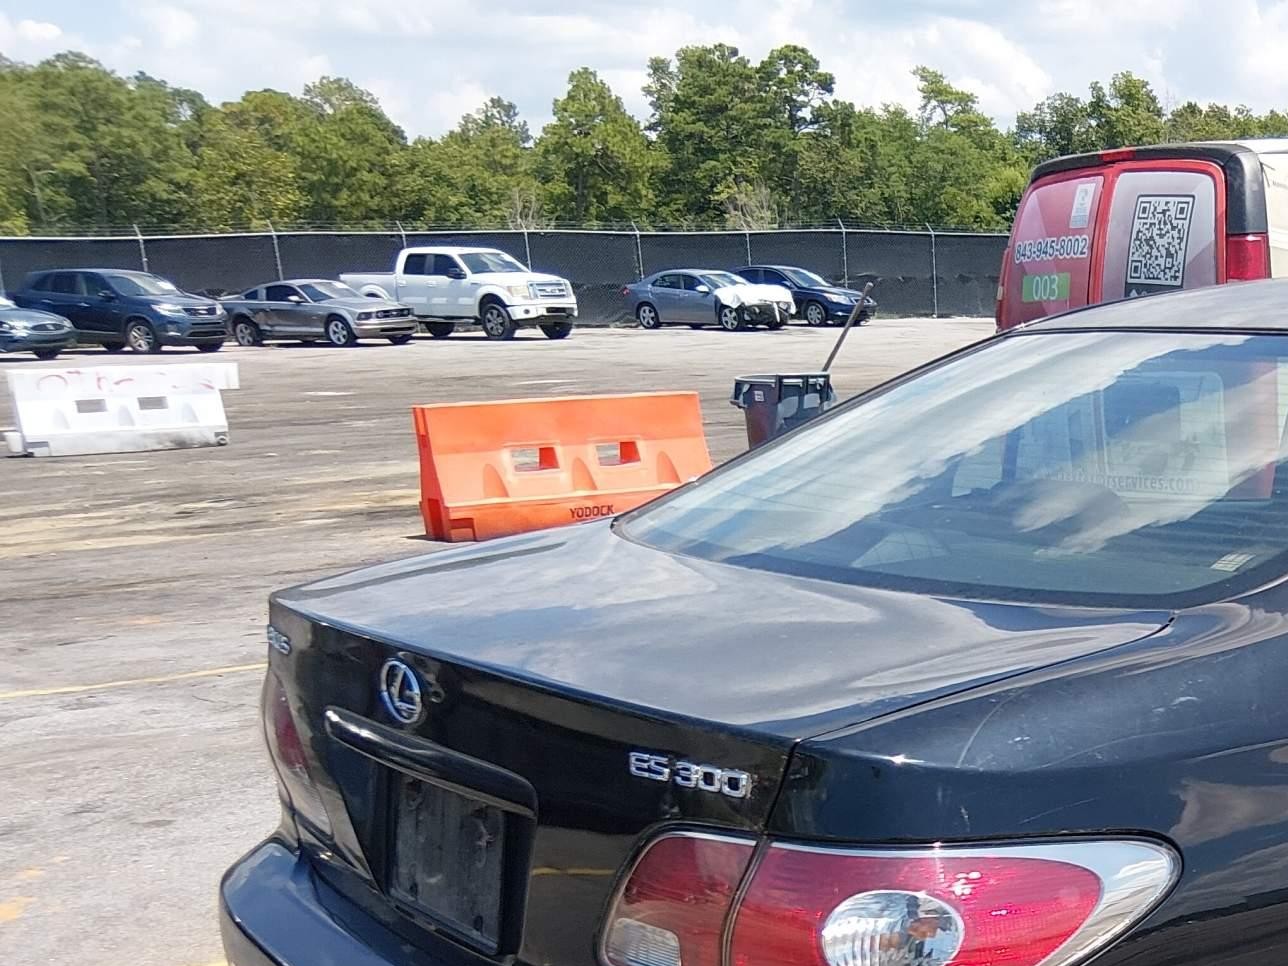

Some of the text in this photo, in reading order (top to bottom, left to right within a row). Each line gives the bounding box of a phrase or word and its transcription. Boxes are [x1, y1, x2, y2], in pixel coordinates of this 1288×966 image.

[1015, 235, 1088, 264] 843-945-8002
[1032, 275, 1058, 300] 003
[569, 505, 615, 519] YODOCK
[629, 751, 750, 798] ES 300
